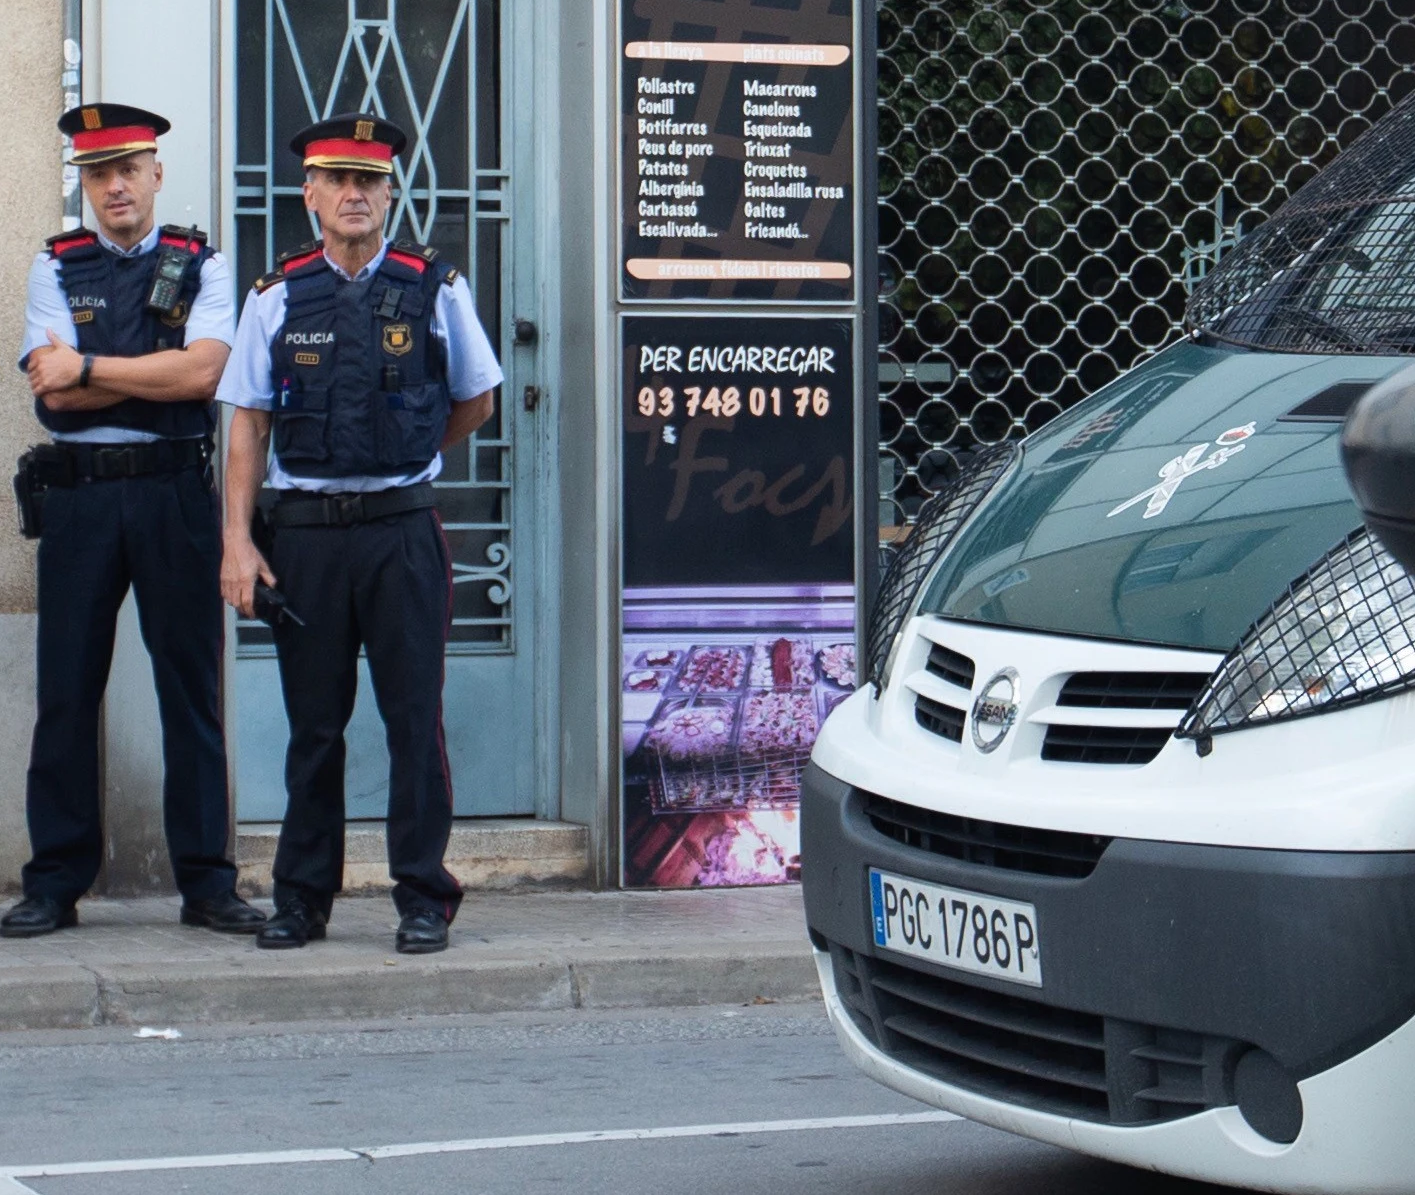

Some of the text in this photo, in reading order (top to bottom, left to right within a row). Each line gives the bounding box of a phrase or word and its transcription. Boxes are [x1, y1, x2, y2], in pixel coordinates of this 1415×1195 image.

[638, 77, 695, 95] Pollastre
[743, 80, 817, 97] Macarrons
[638, 98, 674, 115] Conill
[743, 101, 800, 118] Canelons
[638, 119, 707, 135] Botifarres
[744, 121, 812, 140] Esqueixada
[638, 139, 713, 158] Peus de porc
[744, 142, 791, 157] Trinxat
[639, 159, 688, 176] Patates
[744, 161, 807, 180] Croquetes
[744, 182, 843, 199] Ensaladilla rusa
[639, 201, 697, 217] Carbassó
[744, 202, 785, 218] Galtes
[639, 221, 718, 237] Escalivada...
[68, 296, 106, 308] OLICIA
[285, 332, 334, 344] POLICIA
[640, 345, 835, 376] PER ENCARREGAR
[638, 386, 830, 417] 93 748 01 76
[875, 916, 883, 933] E
[884, 882, 932, 950] PGC
